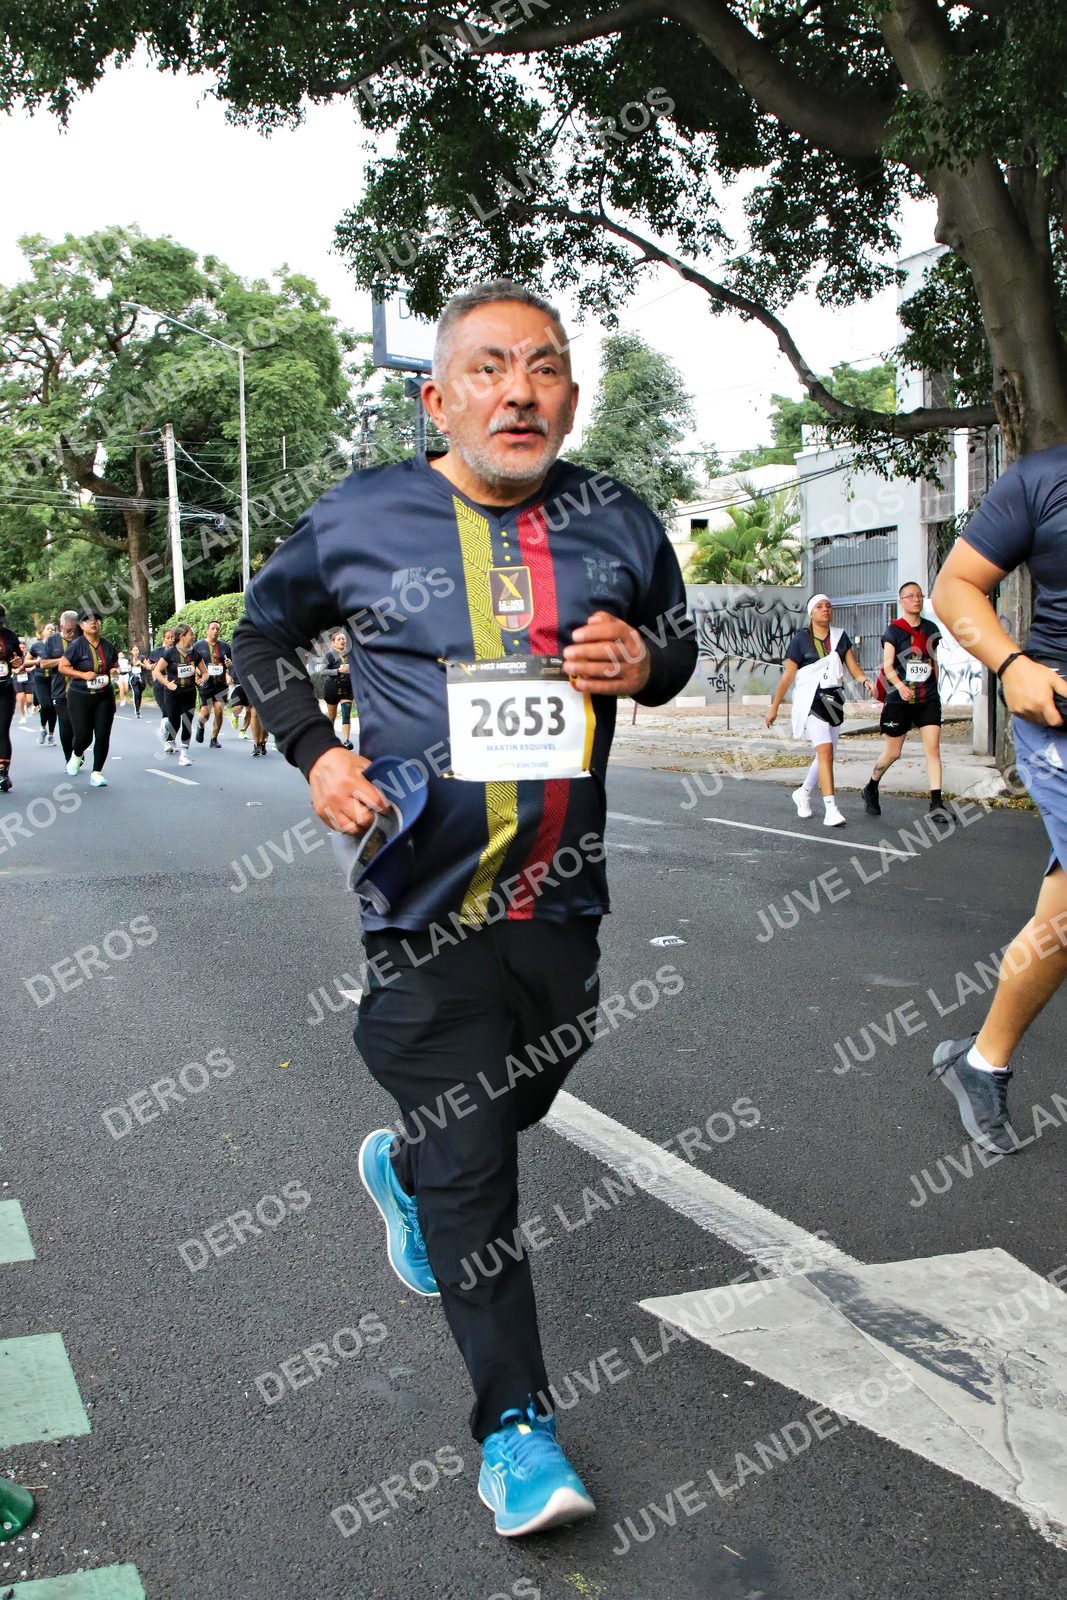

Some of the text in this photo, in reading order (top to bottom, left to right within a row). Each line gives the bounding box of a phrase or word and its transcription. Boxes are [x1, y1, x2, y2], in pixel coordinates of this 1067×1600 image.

[910, 666, 928, 674] 6390
[470, 696, 566, 738] 2653
[486, 743, 556, 752] MARTIN ESQUIVEL
